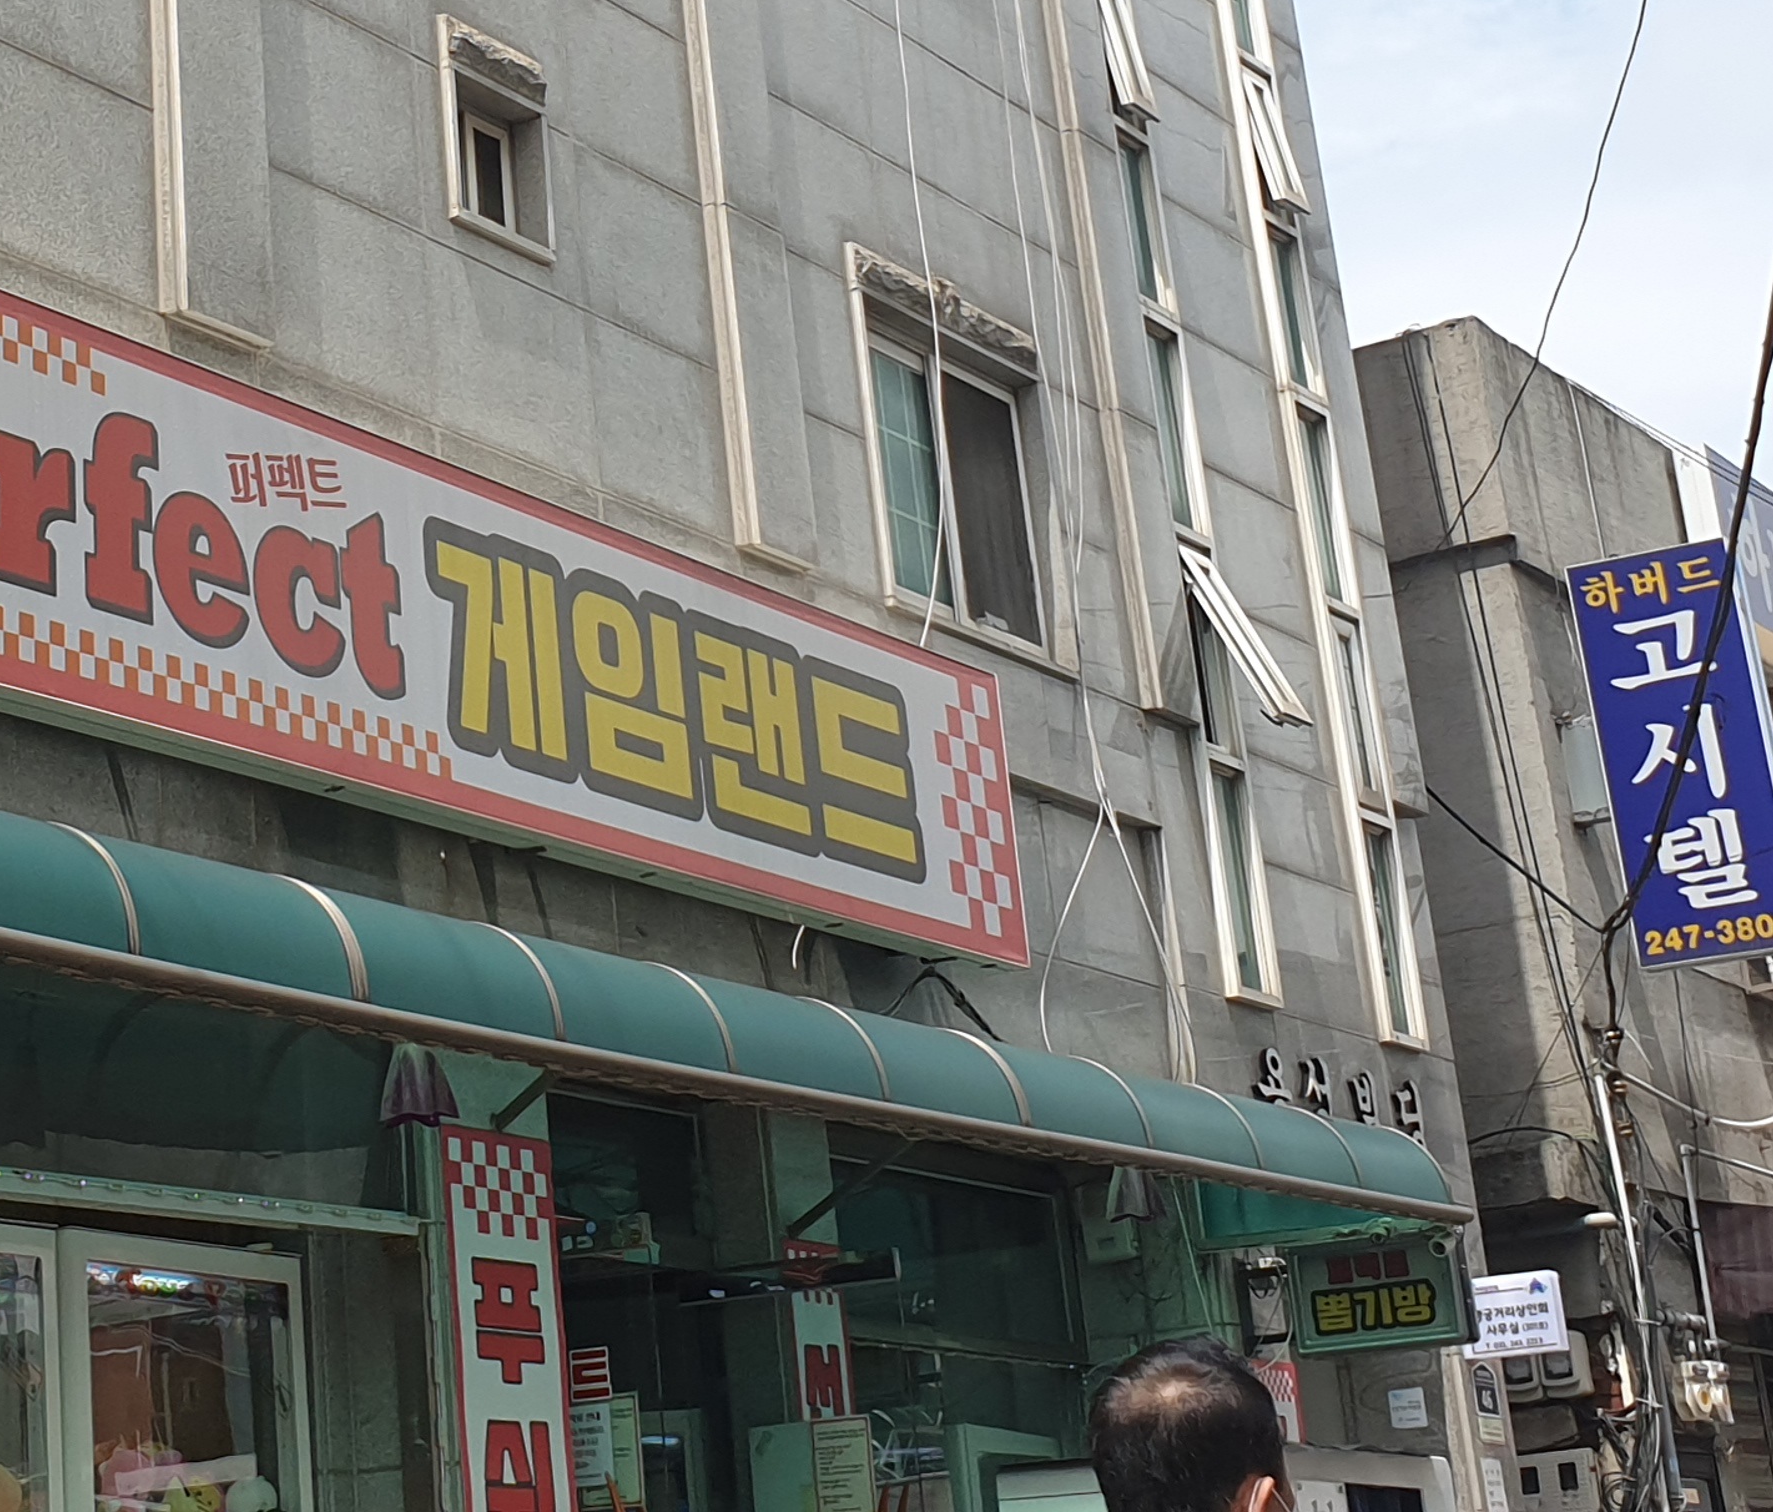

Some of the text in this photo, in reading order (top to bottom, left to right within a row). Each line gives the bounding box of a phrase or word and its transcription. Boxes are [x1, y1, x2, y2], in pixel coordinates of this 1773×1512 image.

[225, 452, 347, 512] 퍼펙트
[1579, 557, 1722, 614] 하버드
[432, 534, 920, 870] 게임랜드
[1610, 609, 1759, 909] 고시텔
[1644, 913, 1773, 956] 247-380
[1314, 1282, 1433, 1333] 뽑기방
[1486, 1321, 1520, 1336] 사무실
